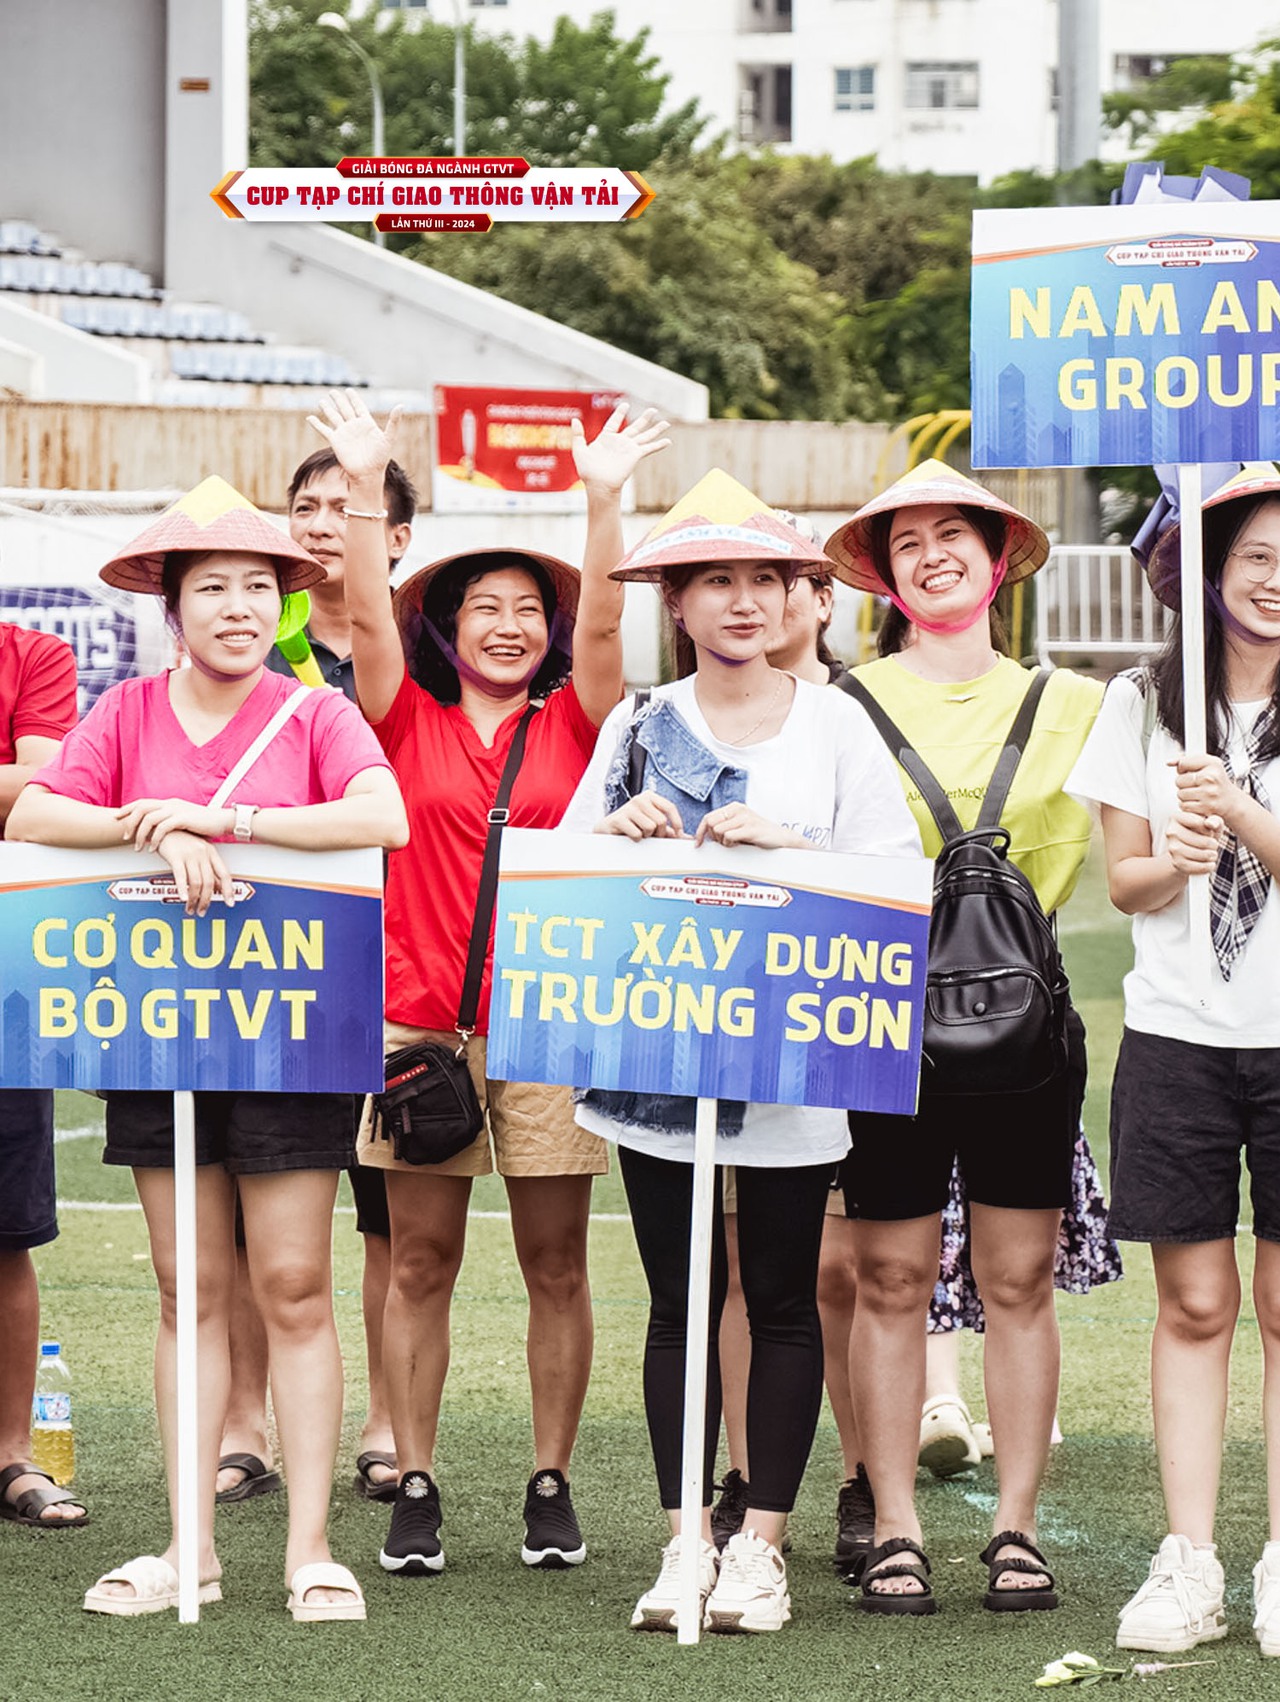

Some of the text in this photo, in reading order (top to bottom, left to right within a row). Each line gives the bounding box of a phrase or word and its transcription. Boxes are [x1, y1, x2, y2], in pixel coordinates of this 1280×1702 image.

[1009, 283, 1181, 339] NAM
[32, 912, 325, 971] CƠ QUAN
[507, 912, 913, 989] TCT XÂY DỰNG
[39, 976, 318, 1050] BỘ GTVT
[501, 967, 913, 1051] TRƯỜNG SƠN
